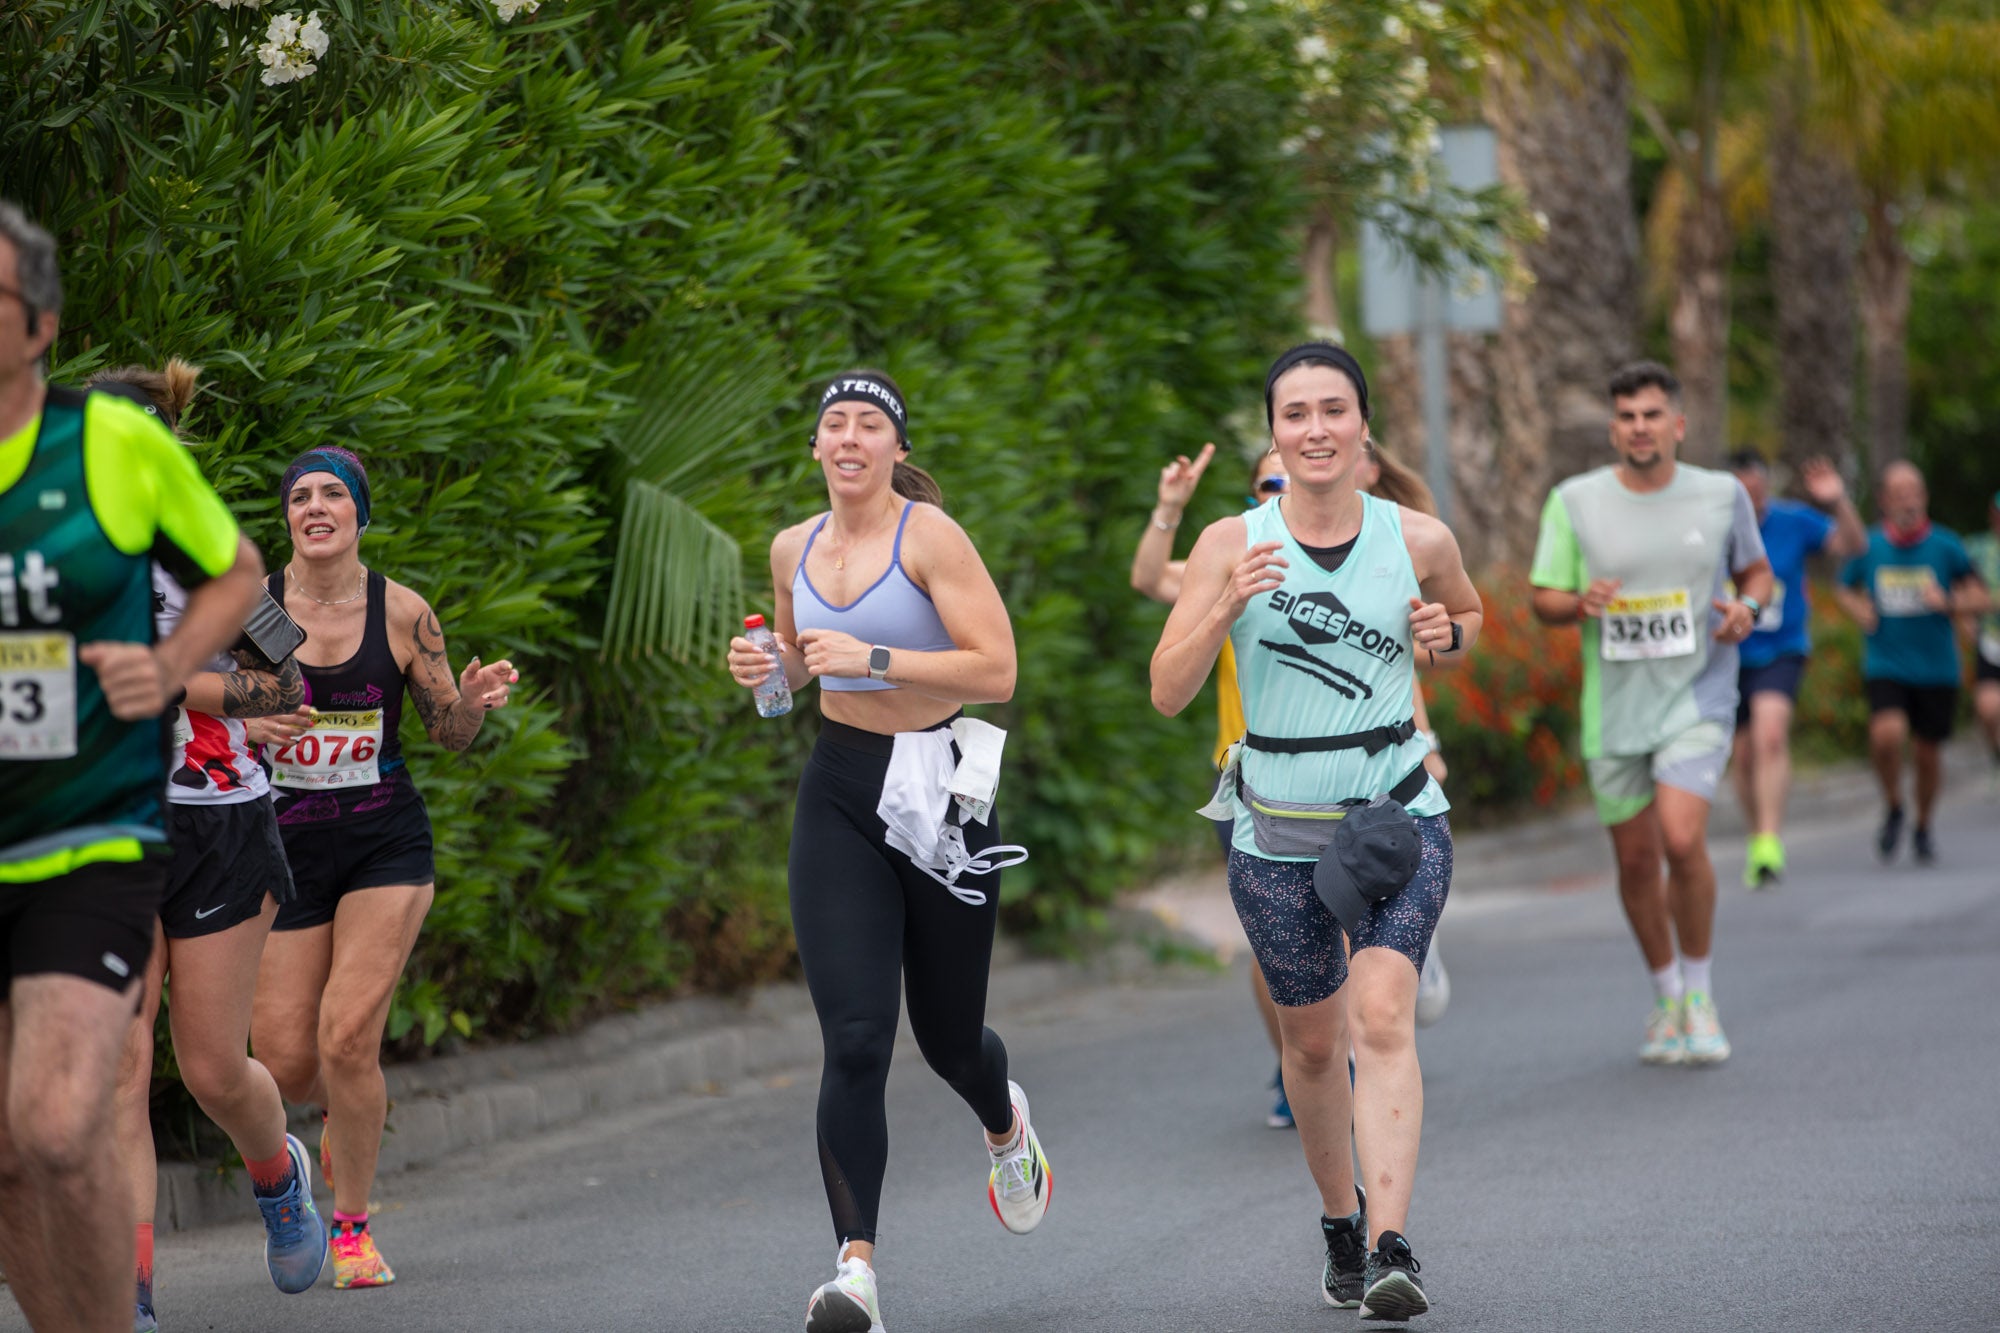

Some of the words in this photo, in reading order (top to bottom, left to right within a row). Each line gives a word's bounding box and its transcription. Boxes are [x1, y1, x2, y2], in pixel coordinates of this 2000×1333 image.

[843, 379, 903, 420] TERREX
[1268, 590, 1405, 664] SIGESPORT
[1608, 613, 1688, 644] 3266
[0, 679, 46, 724] 3
[310, 715, 357, 727] ONDO
[274, 735, 376, 766] 2076
